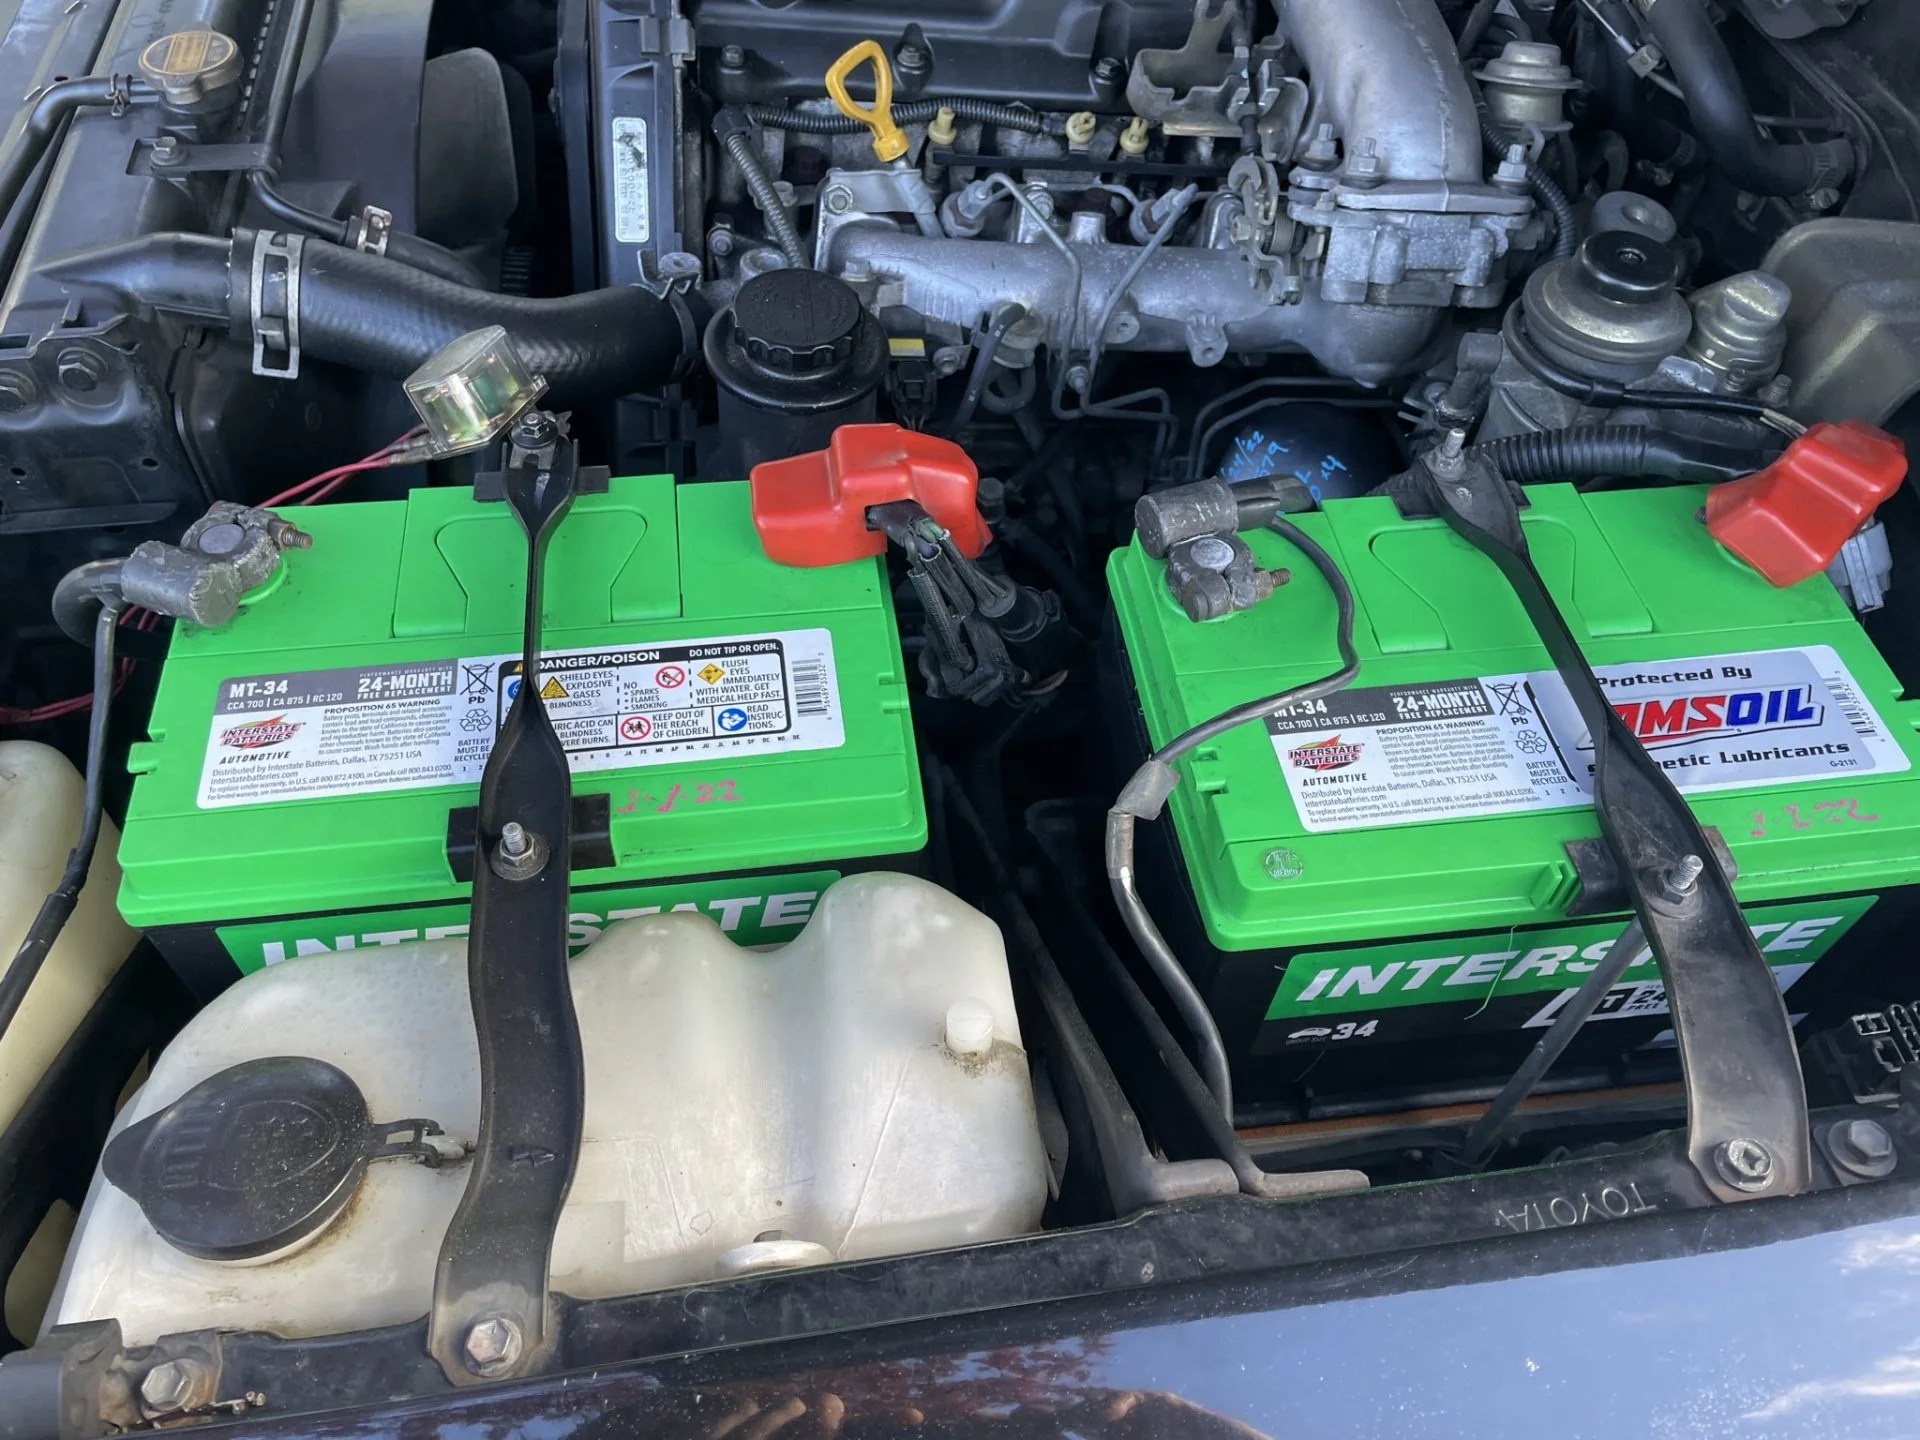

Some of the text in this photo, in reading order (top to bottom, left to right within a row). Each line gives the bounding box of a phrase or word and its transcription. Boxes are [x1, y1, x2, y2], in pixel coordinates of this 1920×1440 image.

[689, 643, 780, 657] DO NOT TIP OR OPEN.
[721, 659, 748, 668] FLUSH
[560, 670, 616, 682] SHIELD EYES.
[730, 667, 750, 675] EYES
[1721, 666, 1753, 680] By
[358, 671, 453, 693] 24-MONTH
[566, 680, 613, 690] EXPLOSIVE
[722, 673, 780, 684] IMMEDIATELY
[229, 680, 289, 698] MT-34
[357, 686, 452, 700] FREE REPLACEMENT
[573, 690, 601, 699] GASES
[630, 688, 660, 696] SPARKS
[696, 682, 770, 695] WITH WATER. GET
[227, 693, 343, 710] CCA 700 CA 875 RC 120
[468, 696, 485, 704] Pb
[630, 695, 660, 703] FLAMES
[697, 691, 782, 704] MEDICAL HELP FAST.
[1393, 690, 1485, 713] 24-MONTH
[324, 699, 441, 714] PROPOSITION 65 WARNING
[549, 700, 592, 709] BLINDNESS
[630, 701, 668, 710] SMOKING
[747, 704, 769, 712] READ
[653, 713, 674, 721] KEEP
[675, 711, 692, 719] OUT
[1400, 705, 1488, 720] FREE REPLACEMENT
[574, 720, 596, 729] ACID
[598, 719, 614, 727] CAN
[653, 720, 699, 730] THE REACH
[1277, 712, 1386, 730] CCA 700 CA 875 RC 120
[1511, 716, 1529, 725] Pb
[223, 723, 300, 737] INTERSTATE
[560, 729, 603, 738] BLINDNESS
[1376, 724, 1432, 735] PROPOSITION
[1444, 720, 1486, 729] WARNING
[223, 732, 292, 745] BATTERIES
[653, 730, 666, 739] OF
[458, 738, 490, 747] BATTERY
[457, 746, 479, 754] MUST
[1290, 745, 1361, 759] INTERSTATE
[1720, 743, 1850, 764] Lubricants
[212, 750, 422, 777] Distributed by Interstate Batteries, Dallas, TX 75251 USA
[219, 751, 292, 765] AUTOMOTIVE
[1295, 754, 1358, 767] BATTERIES
[1526, 760, 1557, 769] BATTERY
[1529, 769, 1551, 777] MUST
[1301, 788, 1343, 799] Distributed
[1343, 787, 1352, 796] by
[1353, 784, 1387, 794] Interstate
[1446, 777, 1456, 785] TX
[1481, 773, 1498, 782] USA
[1302, 773, 1368, 787] AUTOMOTIVE
[1531, 776, 1568, 786] RECYCLED
[1331, 1020, 1379, 1040] 34
[1498, 1183, 1657, 1232] TOYOTA
